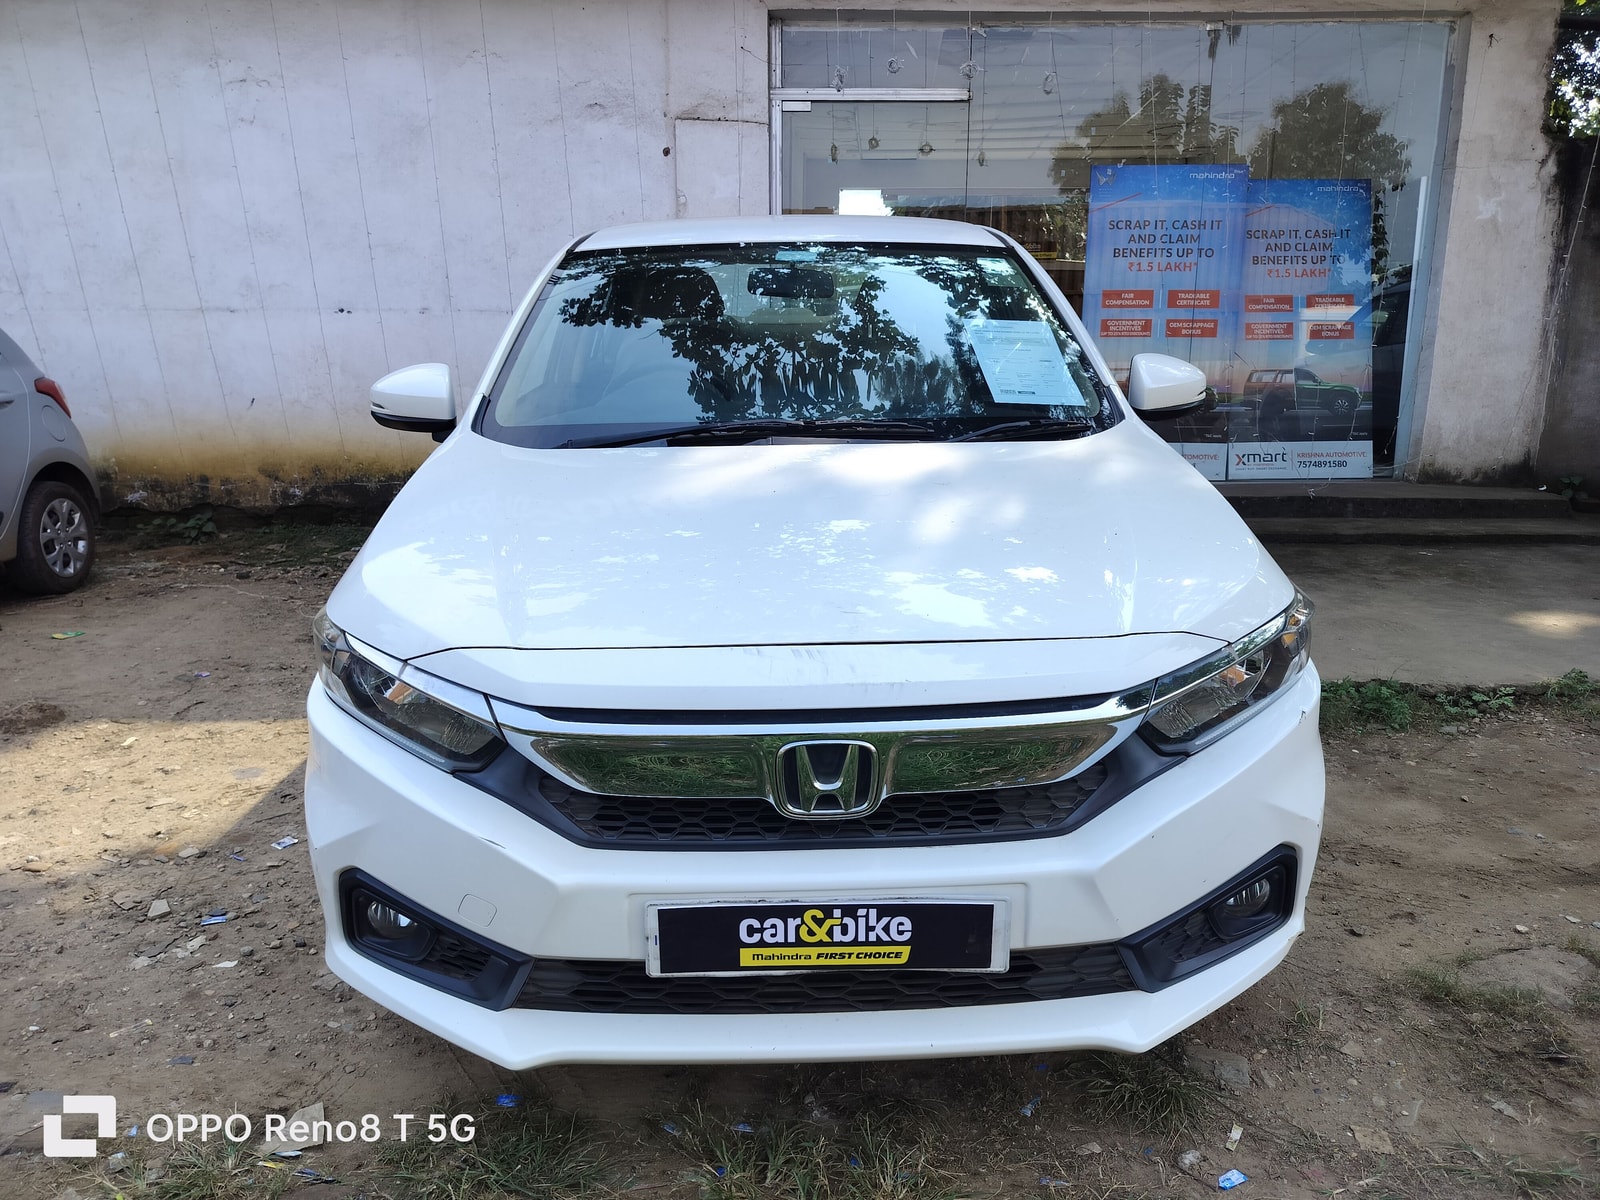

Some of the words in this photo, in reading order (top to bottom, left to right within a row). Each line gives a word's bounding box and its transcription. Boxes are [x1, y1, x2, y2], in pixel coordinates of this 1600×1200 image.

[1189, 171, 1235, 179] mahindra
[1108, 219, 1150, 230] SCRAP
[1154, 219, 1168, 232] IT,
[1172, 219, 1207, 230] CASH
[1210, 219, 1223, 230] IT
[1127, 233, 1156, 244] AND
[1160, 233, 1200, 244] CLAIM
[1246, 229, 1285, 240] SCRAP
[1304, 229, 1337, 239] CASH
[1340, 228, 1351, 239] IT
[1113, 247, 1173, 258] BENEFITS
[1176, 247, 1194, 258] UP
[1197, 247, 1215, 258] TO
[1265, 242, 1291, 252] AND
[1294, 242, 1333, 252] CLAIM
[1252, 255, 1308, 266] BENEFITS
[1311, 255, 1327, 265] UP
[1329, 254, 1345, 265] TO
[1127, 261, 1154, 272] ₹1.5
[1266, 268, 1291, 278] ₹1.5
[1235, 451, 1288, 466] xmart
[1297, 451, 1324, 459] KRISHNA
[1297, 460, 1348, 469] 7574891580
[739, 908, 913, 944] car&bike
[752, 953, 812, 961] Mahindra
[816, 952, 854, 960] FIRST
[855, 951, 904, 960] CHOICE
